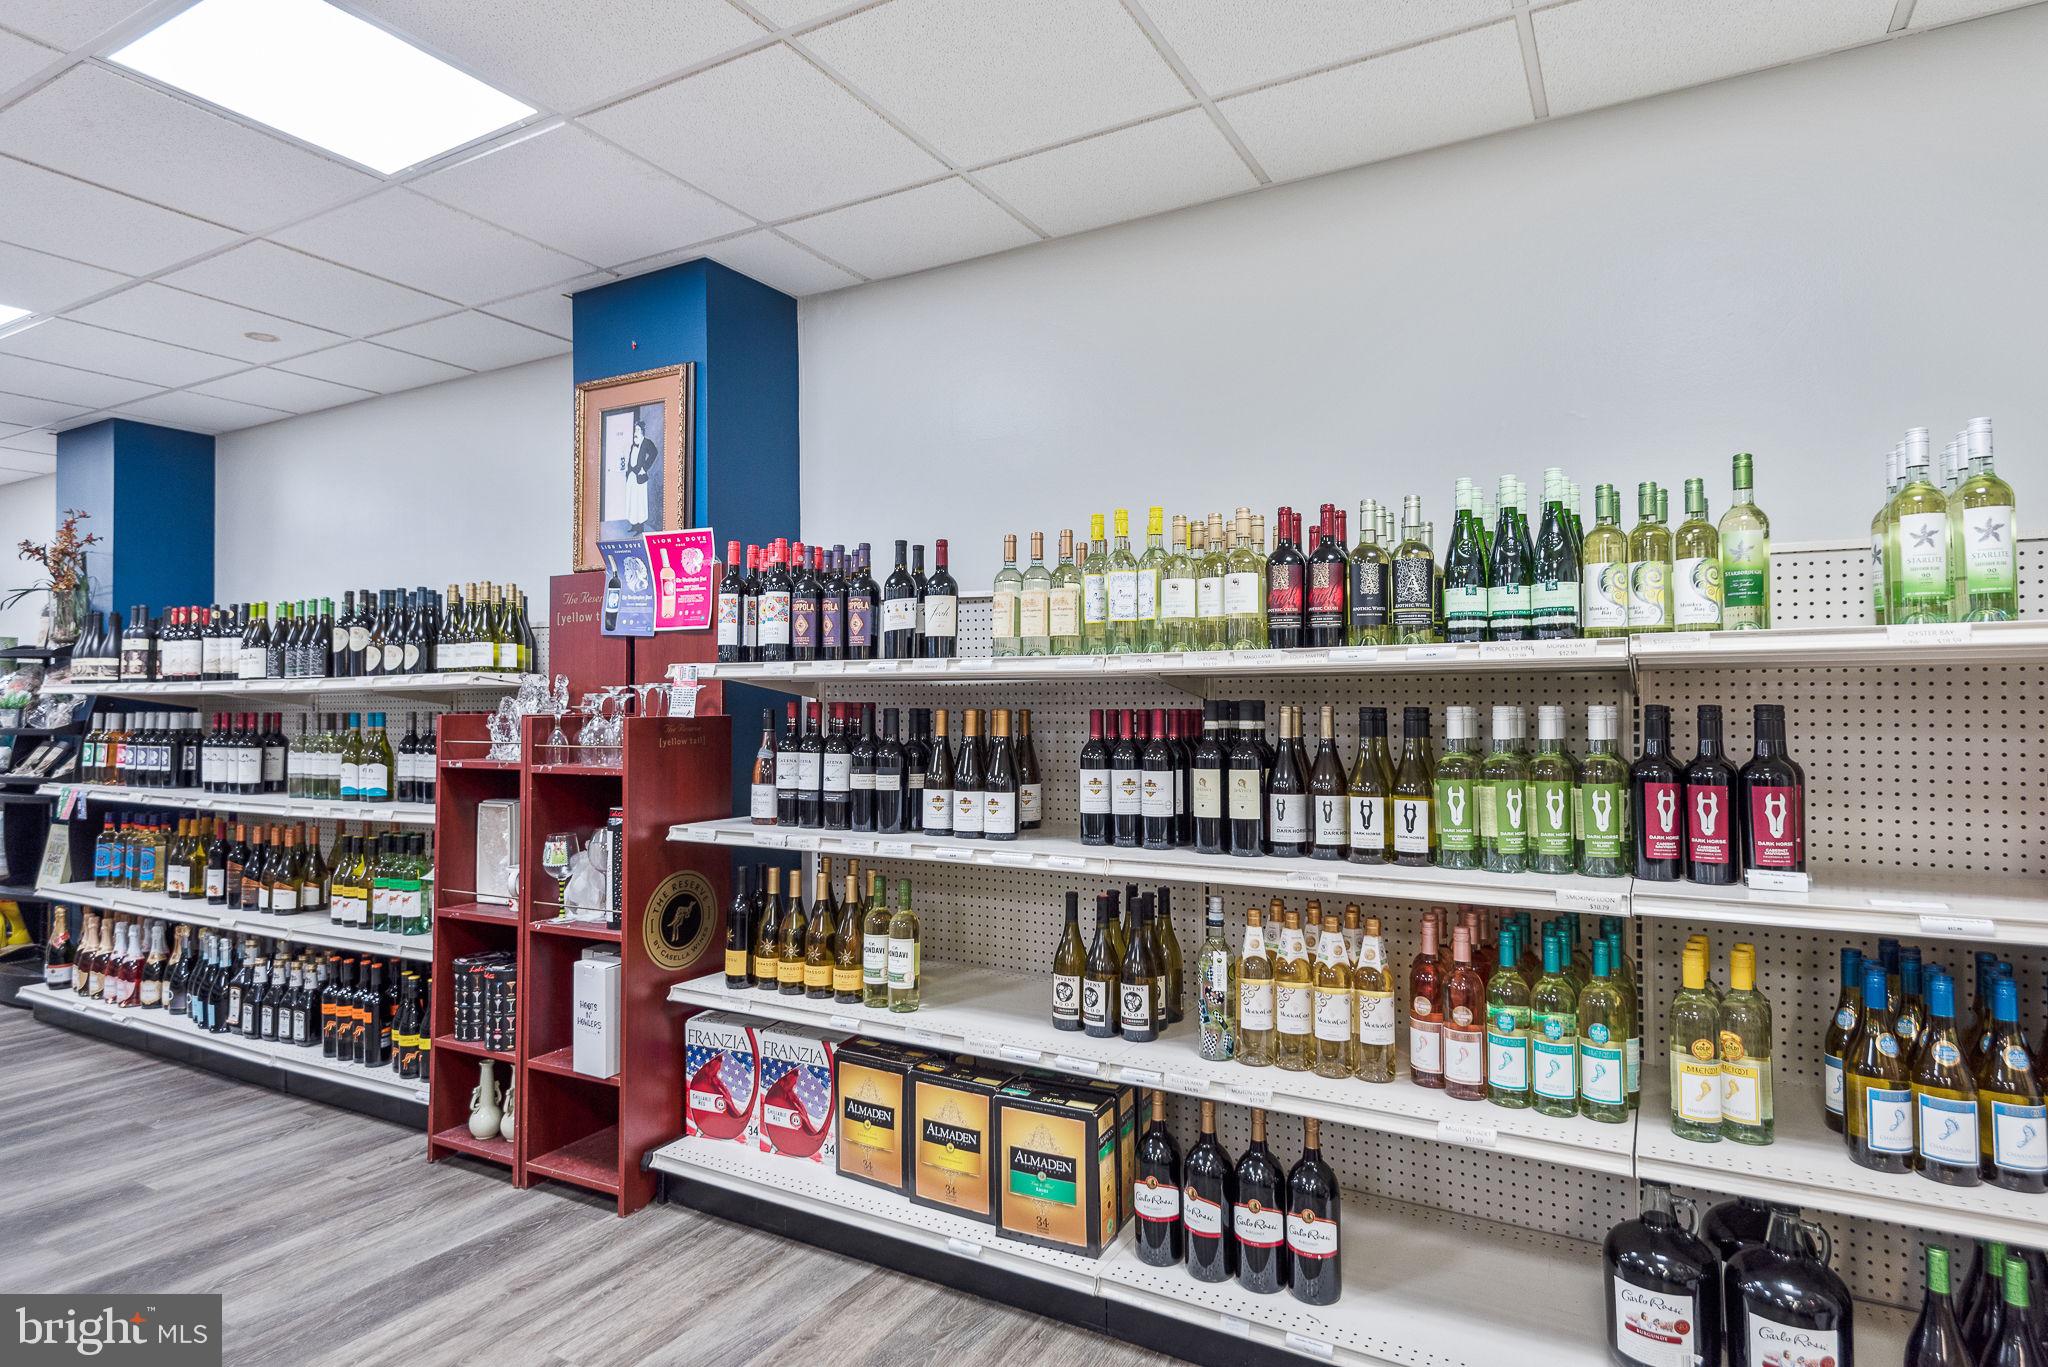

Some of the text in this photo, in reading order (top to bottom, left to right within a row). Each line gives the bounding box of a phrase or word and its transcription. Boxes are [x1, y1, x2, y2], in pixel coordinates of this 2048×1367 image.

[1907, 556, 1943, 564] STARLITE
[1971, 551, 2009, 560] STARLITE
[659, 737, 687, 748] [yellow
[653, 880, 709, 913] THE RESERVE
[653, 939, 661, 950] BY
[660, 949, 690, 961] CASELLA
[577, 1018, 602, 1030] HOWLERS
[688, 1028, 748, 1051] FRANZIA
[763, 1040, 824, 1065] FRANZIA
[848, 1100, 891, 1122] ALMADEN
[748, 1125, 759, 1136] 34
[927, 1122, 977, 1145] ALMADEN
[824, 1143, 835, 1155] 34
[862, 1159, 873, 1172] 34
[1014, 1150, 1073, 1173] ALMADEN
[945, 1184, 957, 1196] 34
[1135, 1191, 1174, 1206] Carlo Rossi
[1190, 1207, 1215, 1222] Rossi
[1036, 1216, 1050, 1229] 34
[1236, 1214, 1279, 1231] Carlo Rossi
[1288, 1224, 1333, 1241] Carlo Rossi
[1621, 1288, 1684, 1315] Carlo Rossi
[1636, 1328, 1668, 1342] BURGUNDY
[1758, 1326, 1829, 1352] Carlo Rossi
